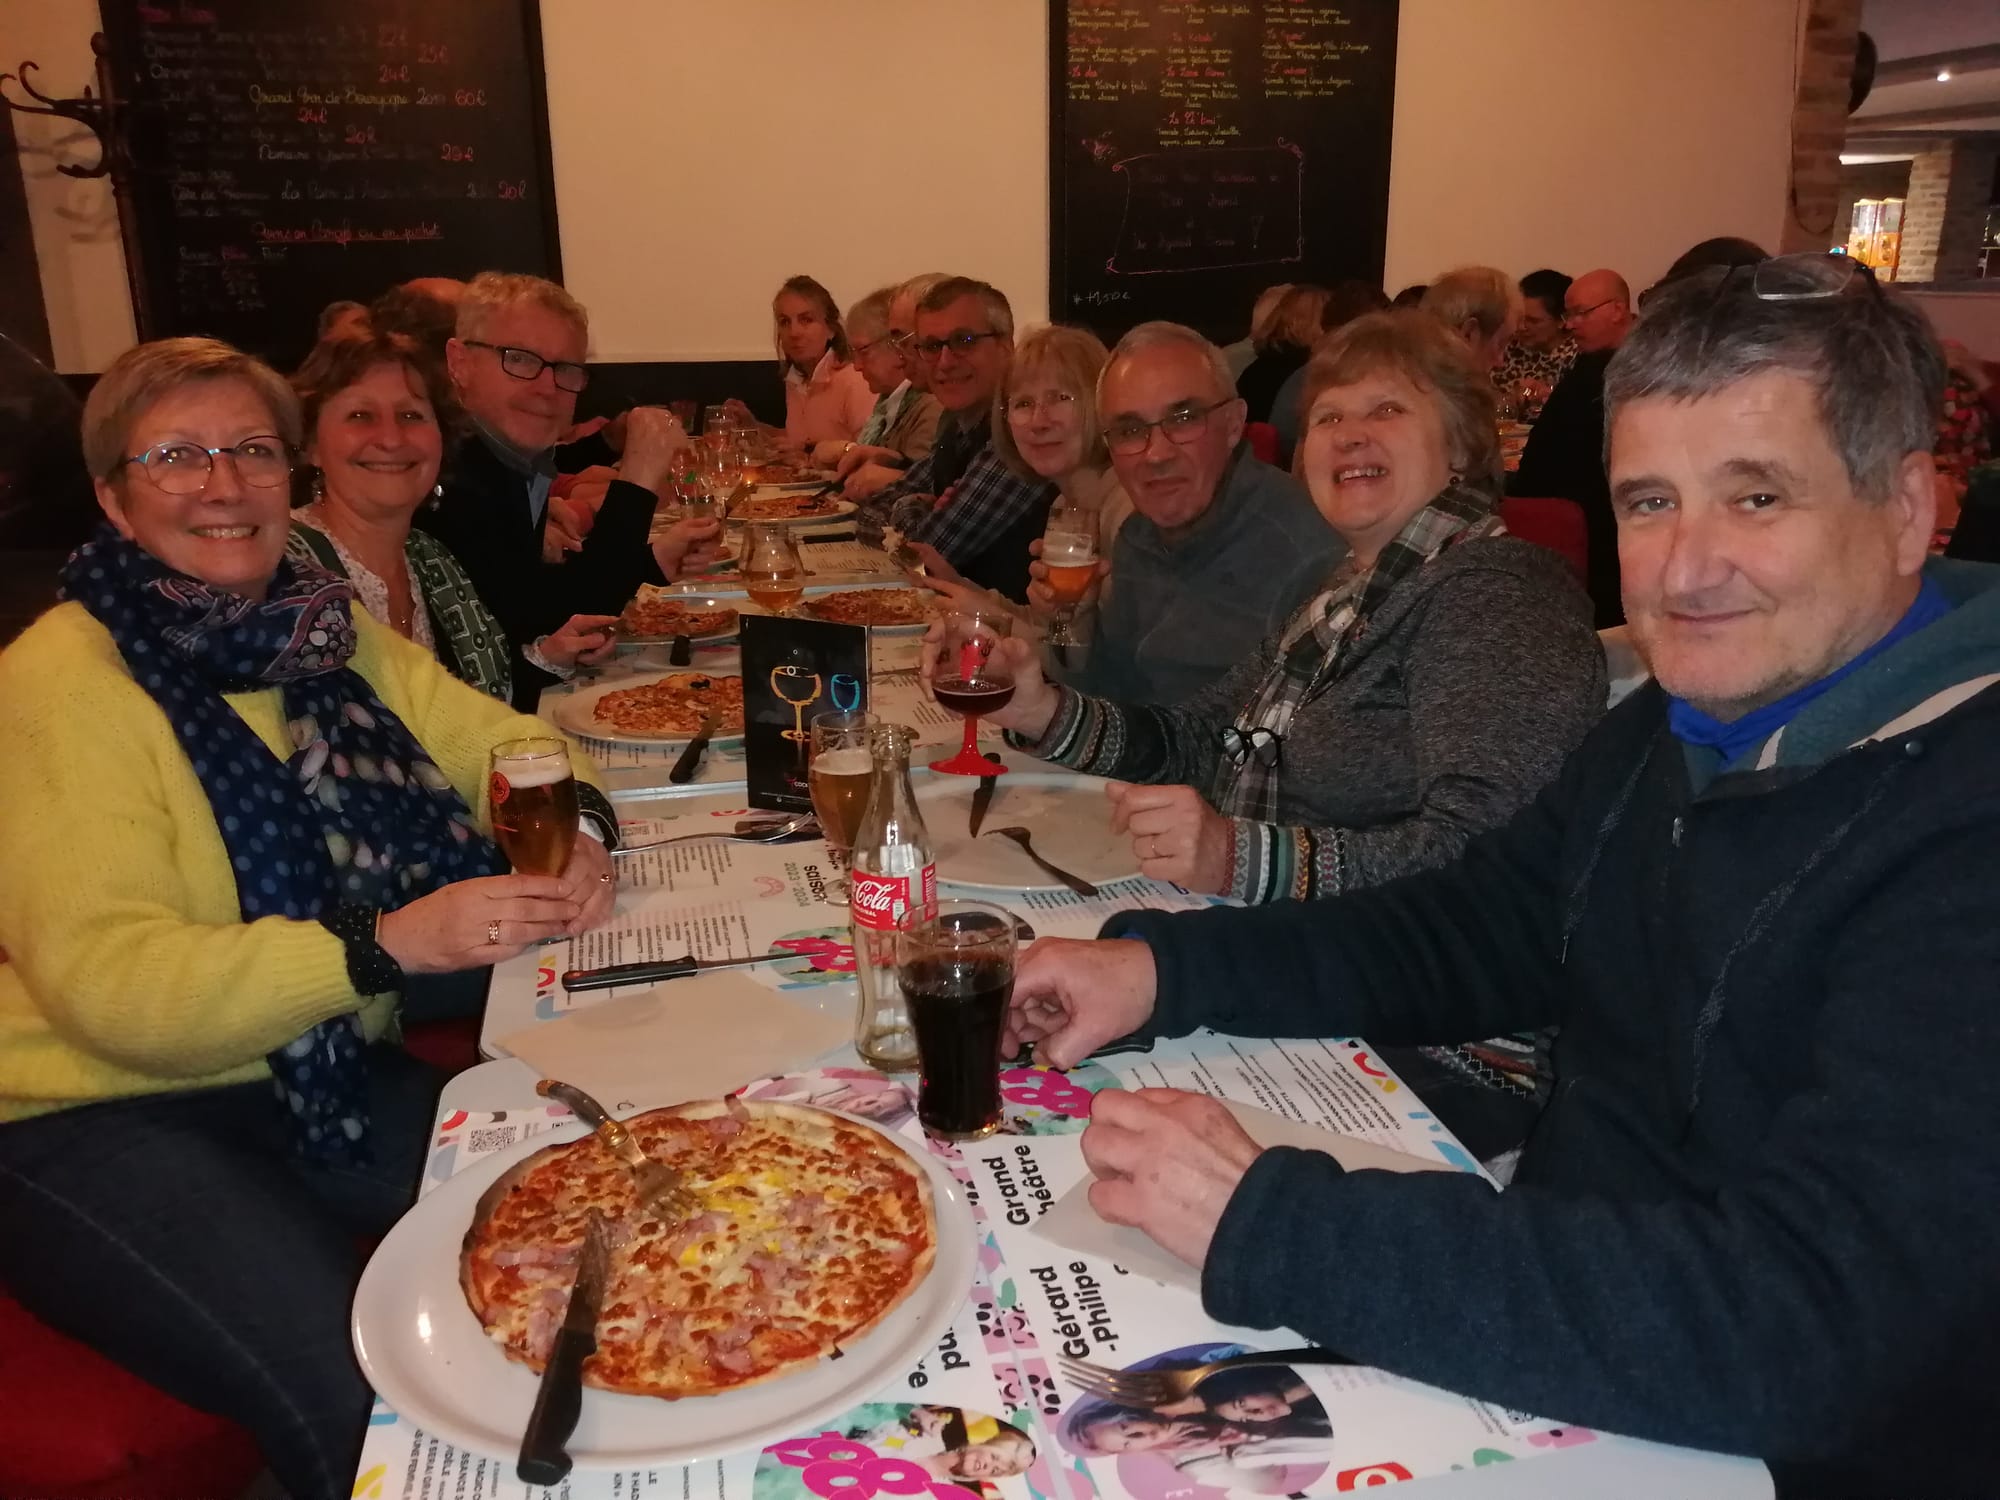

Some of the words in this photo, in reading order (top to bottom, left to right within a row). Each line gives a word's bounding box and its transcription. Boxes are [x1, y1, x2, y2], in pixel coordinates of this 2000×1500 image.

[804, 865, 828, 903] saison
[856, 880, 897, 911] Cola
[982, 1156, 1030, 1225] Grand
[1030, 1266, 1090, 1360] Gérard
